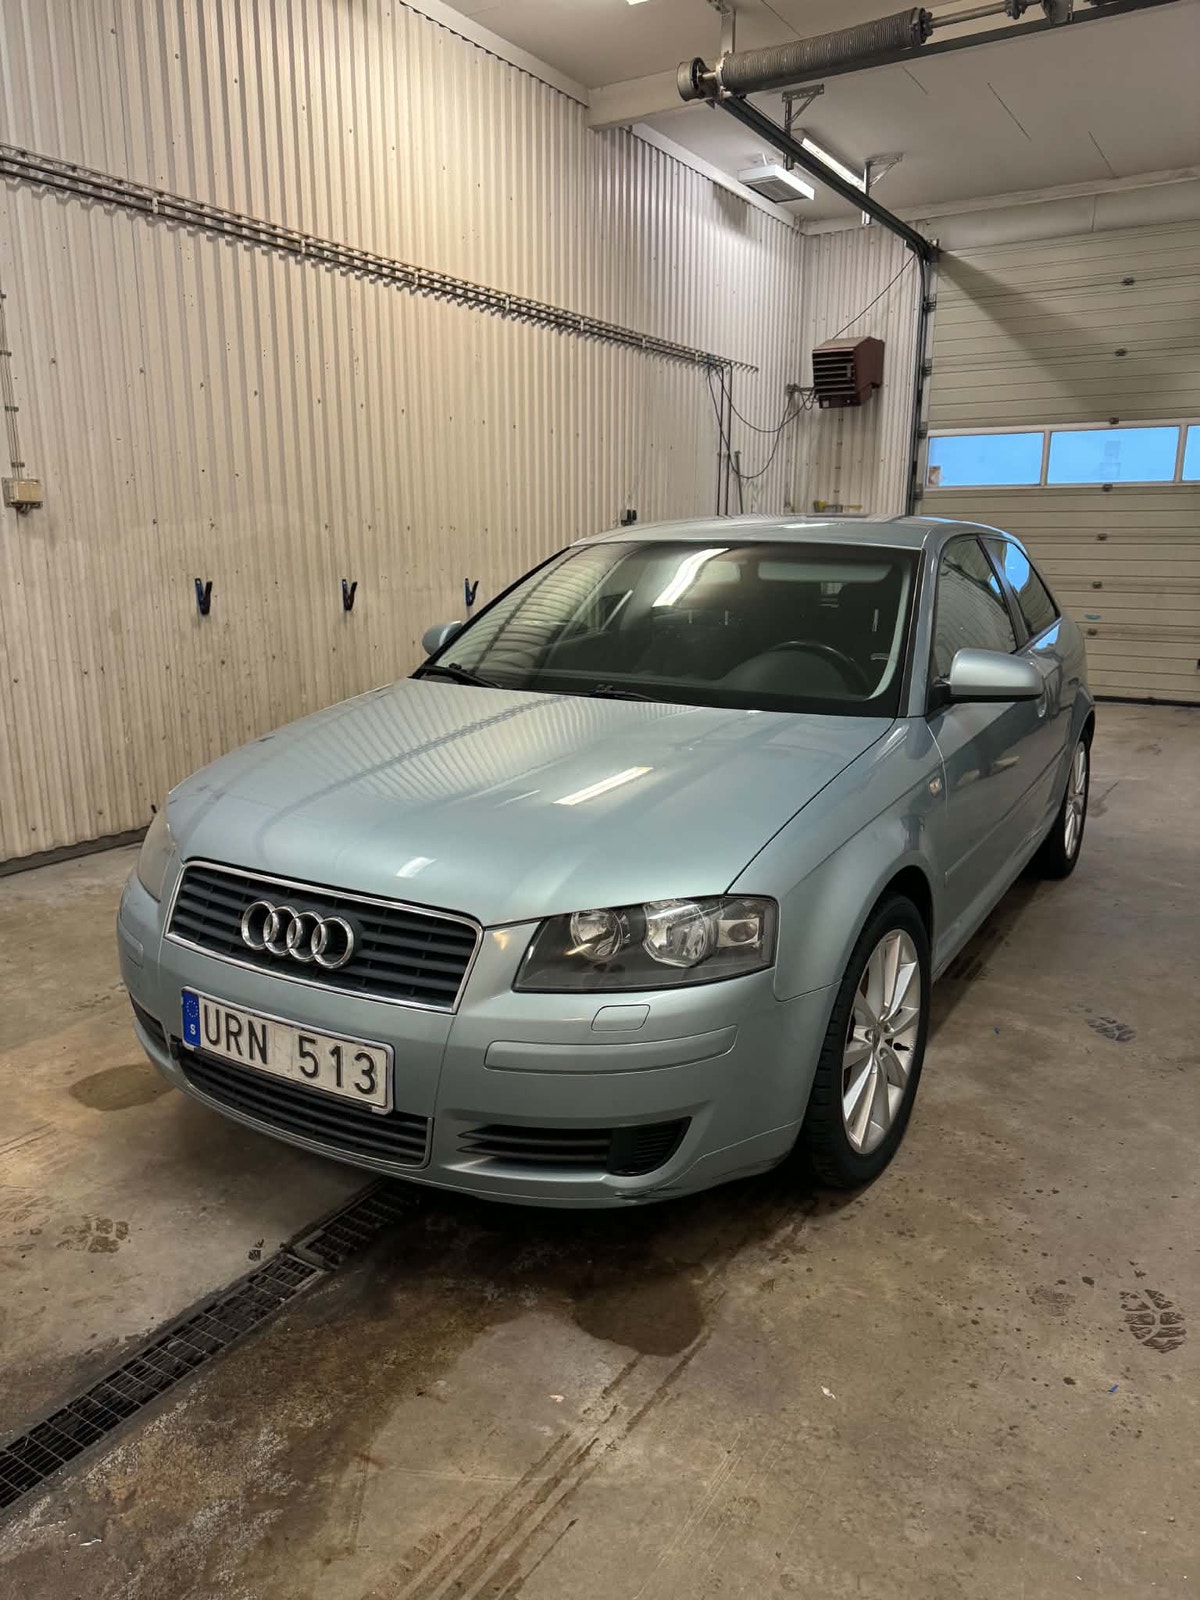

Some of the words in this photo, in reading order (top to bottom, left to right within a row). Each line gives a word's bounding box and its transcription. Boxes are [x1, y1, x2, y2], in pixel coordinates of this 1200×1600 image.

[190, 1024, 196, 1035] S
[204, 1005, 268, 1064] URN
[299, 1034, 376, 1094] 513
